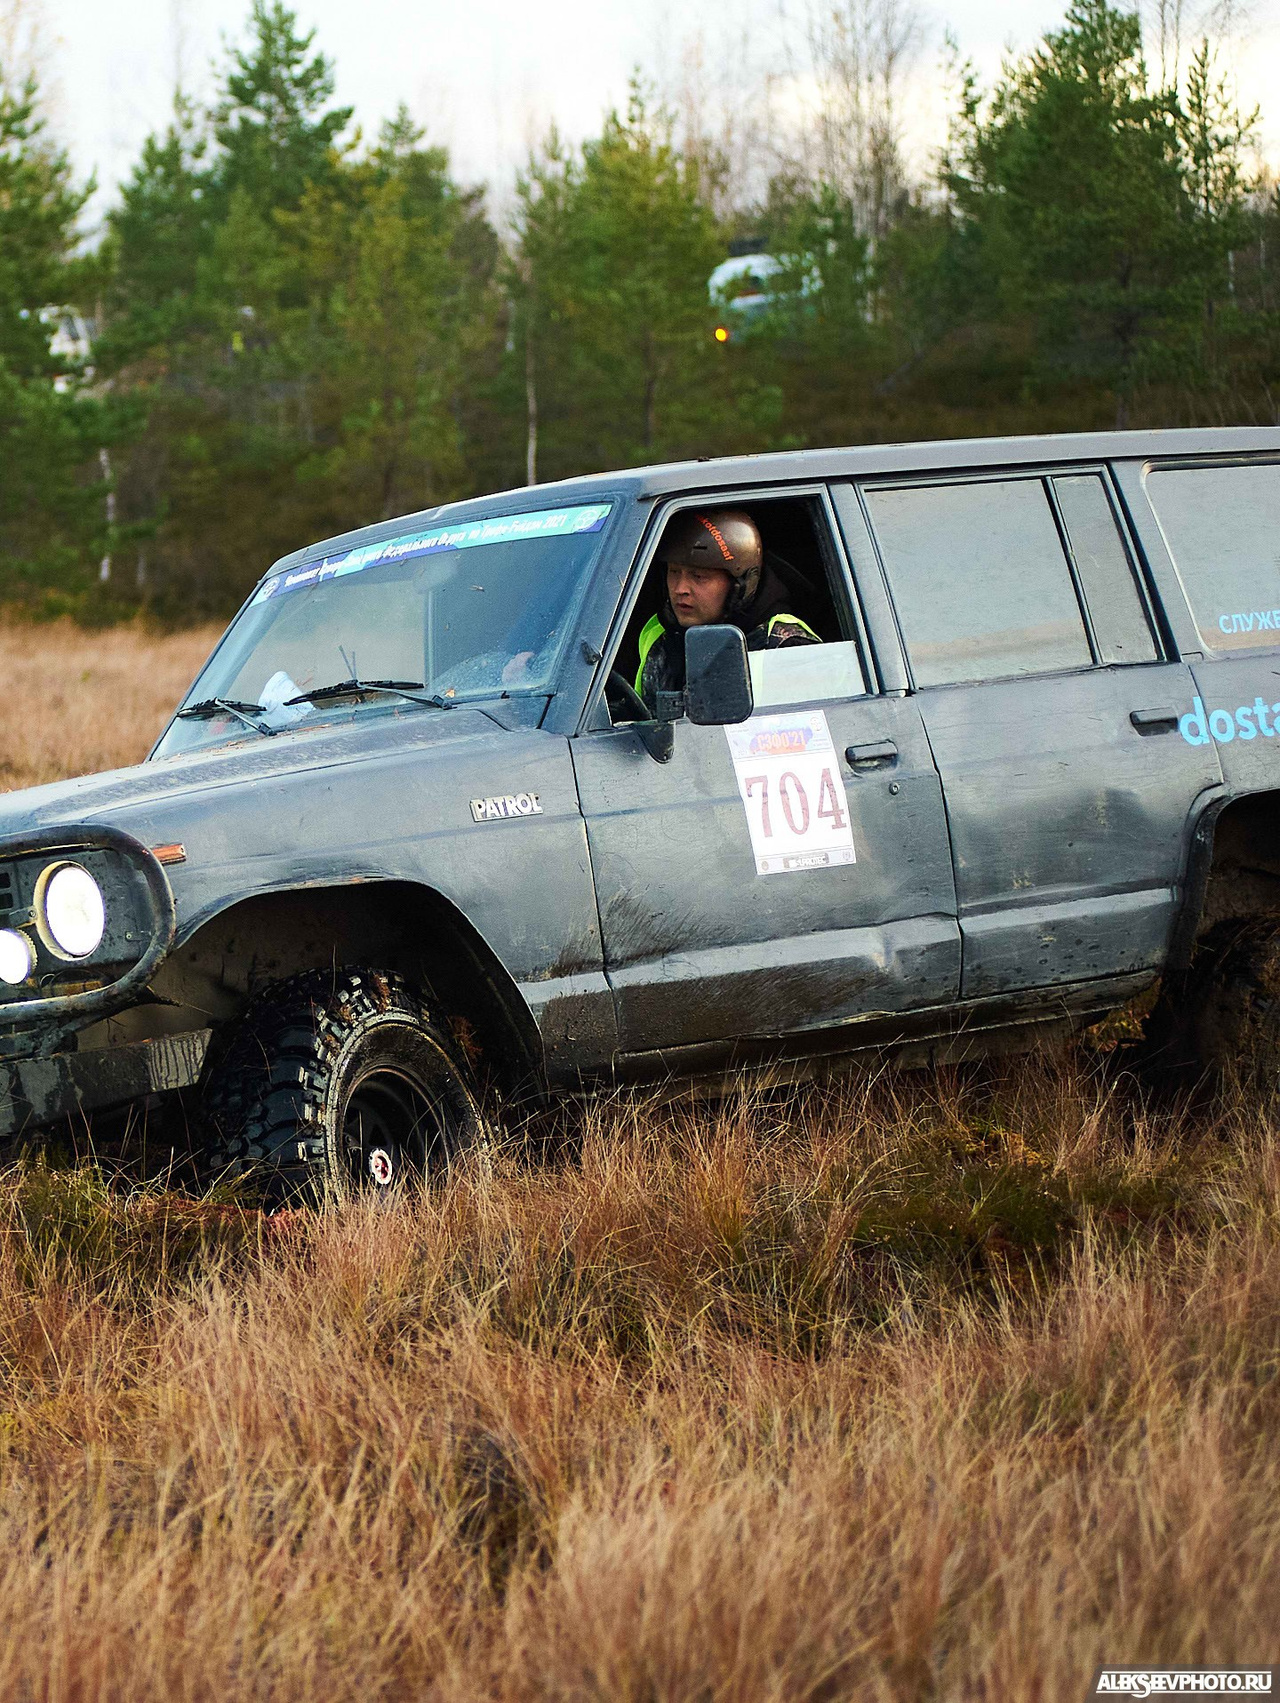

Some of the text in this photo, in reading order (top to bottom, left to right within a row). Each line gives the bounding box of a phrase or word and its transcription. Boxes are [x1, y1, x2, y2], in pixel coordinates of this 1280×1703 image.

[542, 514, 567, 529] 2021
[470, 793, 543, 820] PATROL
[745, 767, 847, 838] 704
